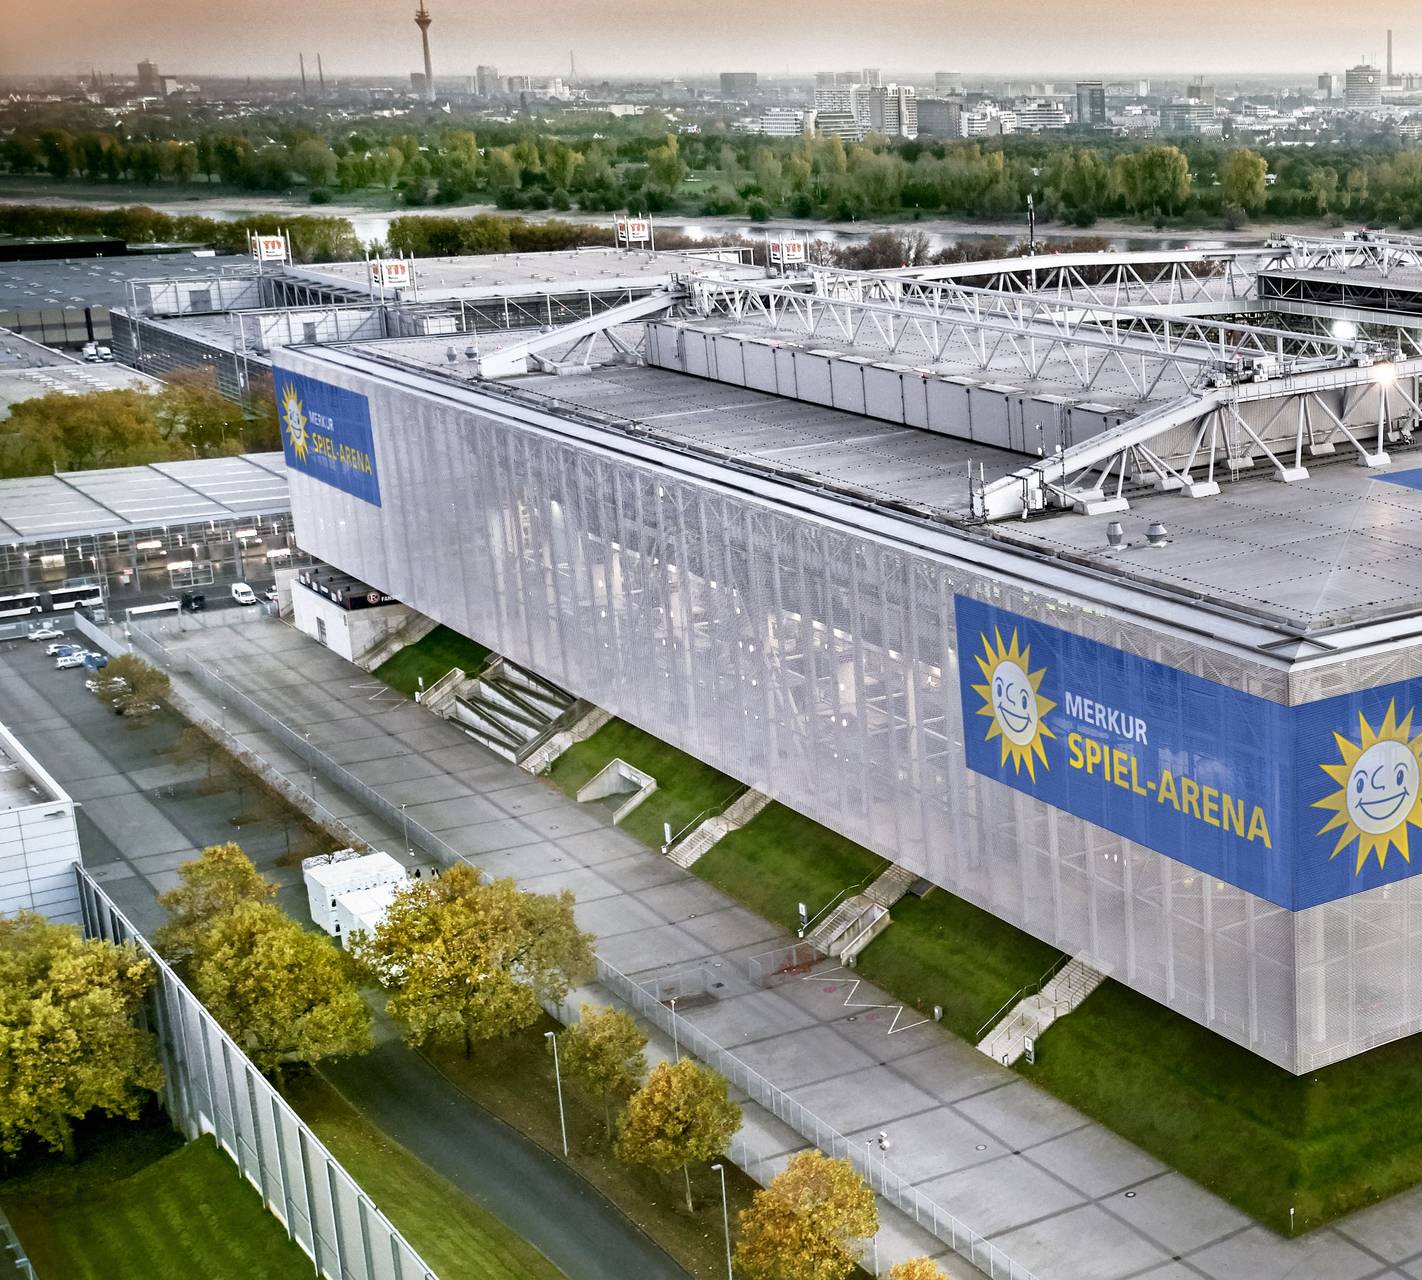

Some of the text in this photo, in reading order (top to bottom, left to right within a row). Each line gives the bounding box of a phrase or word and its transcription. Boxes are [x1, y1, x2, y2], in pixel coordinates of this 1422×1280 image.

[308, 410, 334, 432] MERKUR
[312, 432, 372, 476] SPIEL-ARENA
[1064, 691, 1148, 745] MERKUR
[1067, 732, 1272, 849] SPIEL-ARENA
